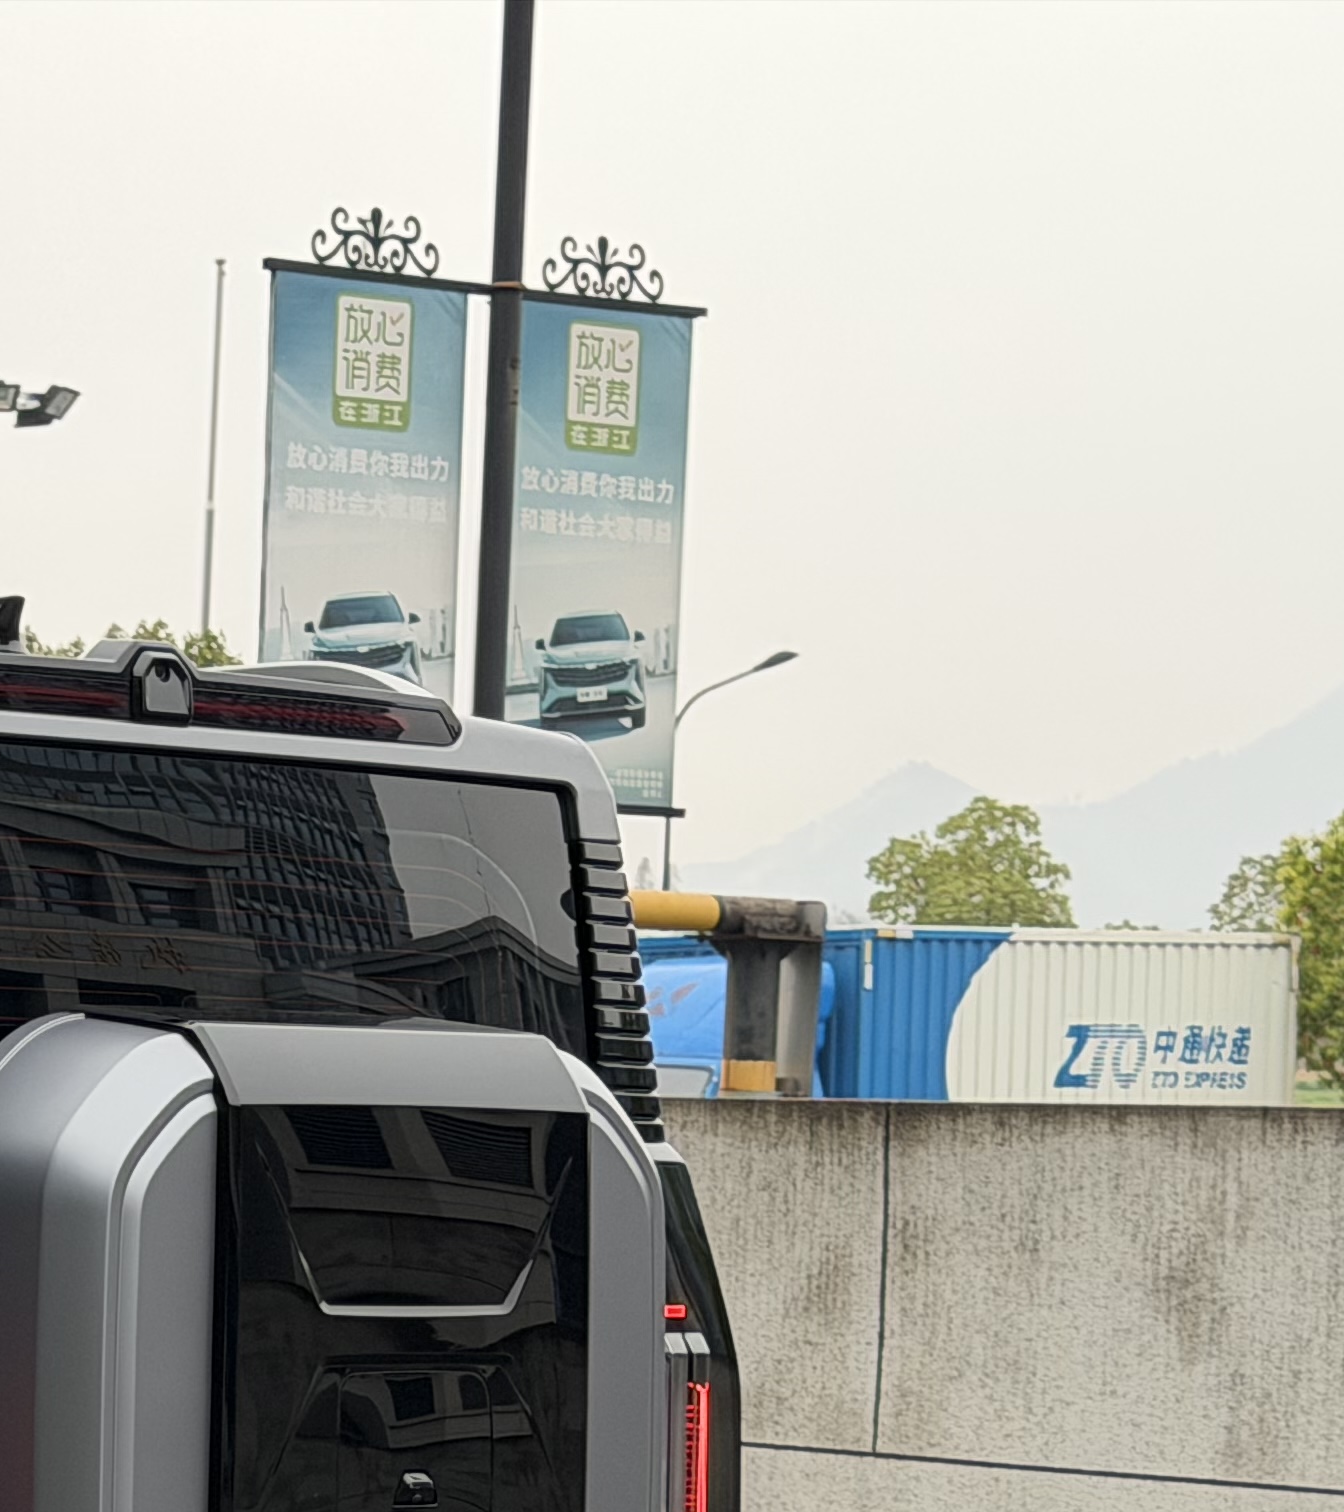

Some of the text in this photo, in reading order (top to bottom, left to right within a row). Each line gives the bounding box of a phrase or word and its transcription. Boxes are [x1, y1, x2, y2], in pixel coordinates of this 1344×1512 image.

[343, 303, 405, 347] 放心
[341, 347, 402, 397] 消费
[576, 330, 634, 374] 放心
[573, 375, 631, 421] 消费
[1053, 1023, 1148, 1089] ZTO
[1150, 1025, 1252, 1065] 中通快递
